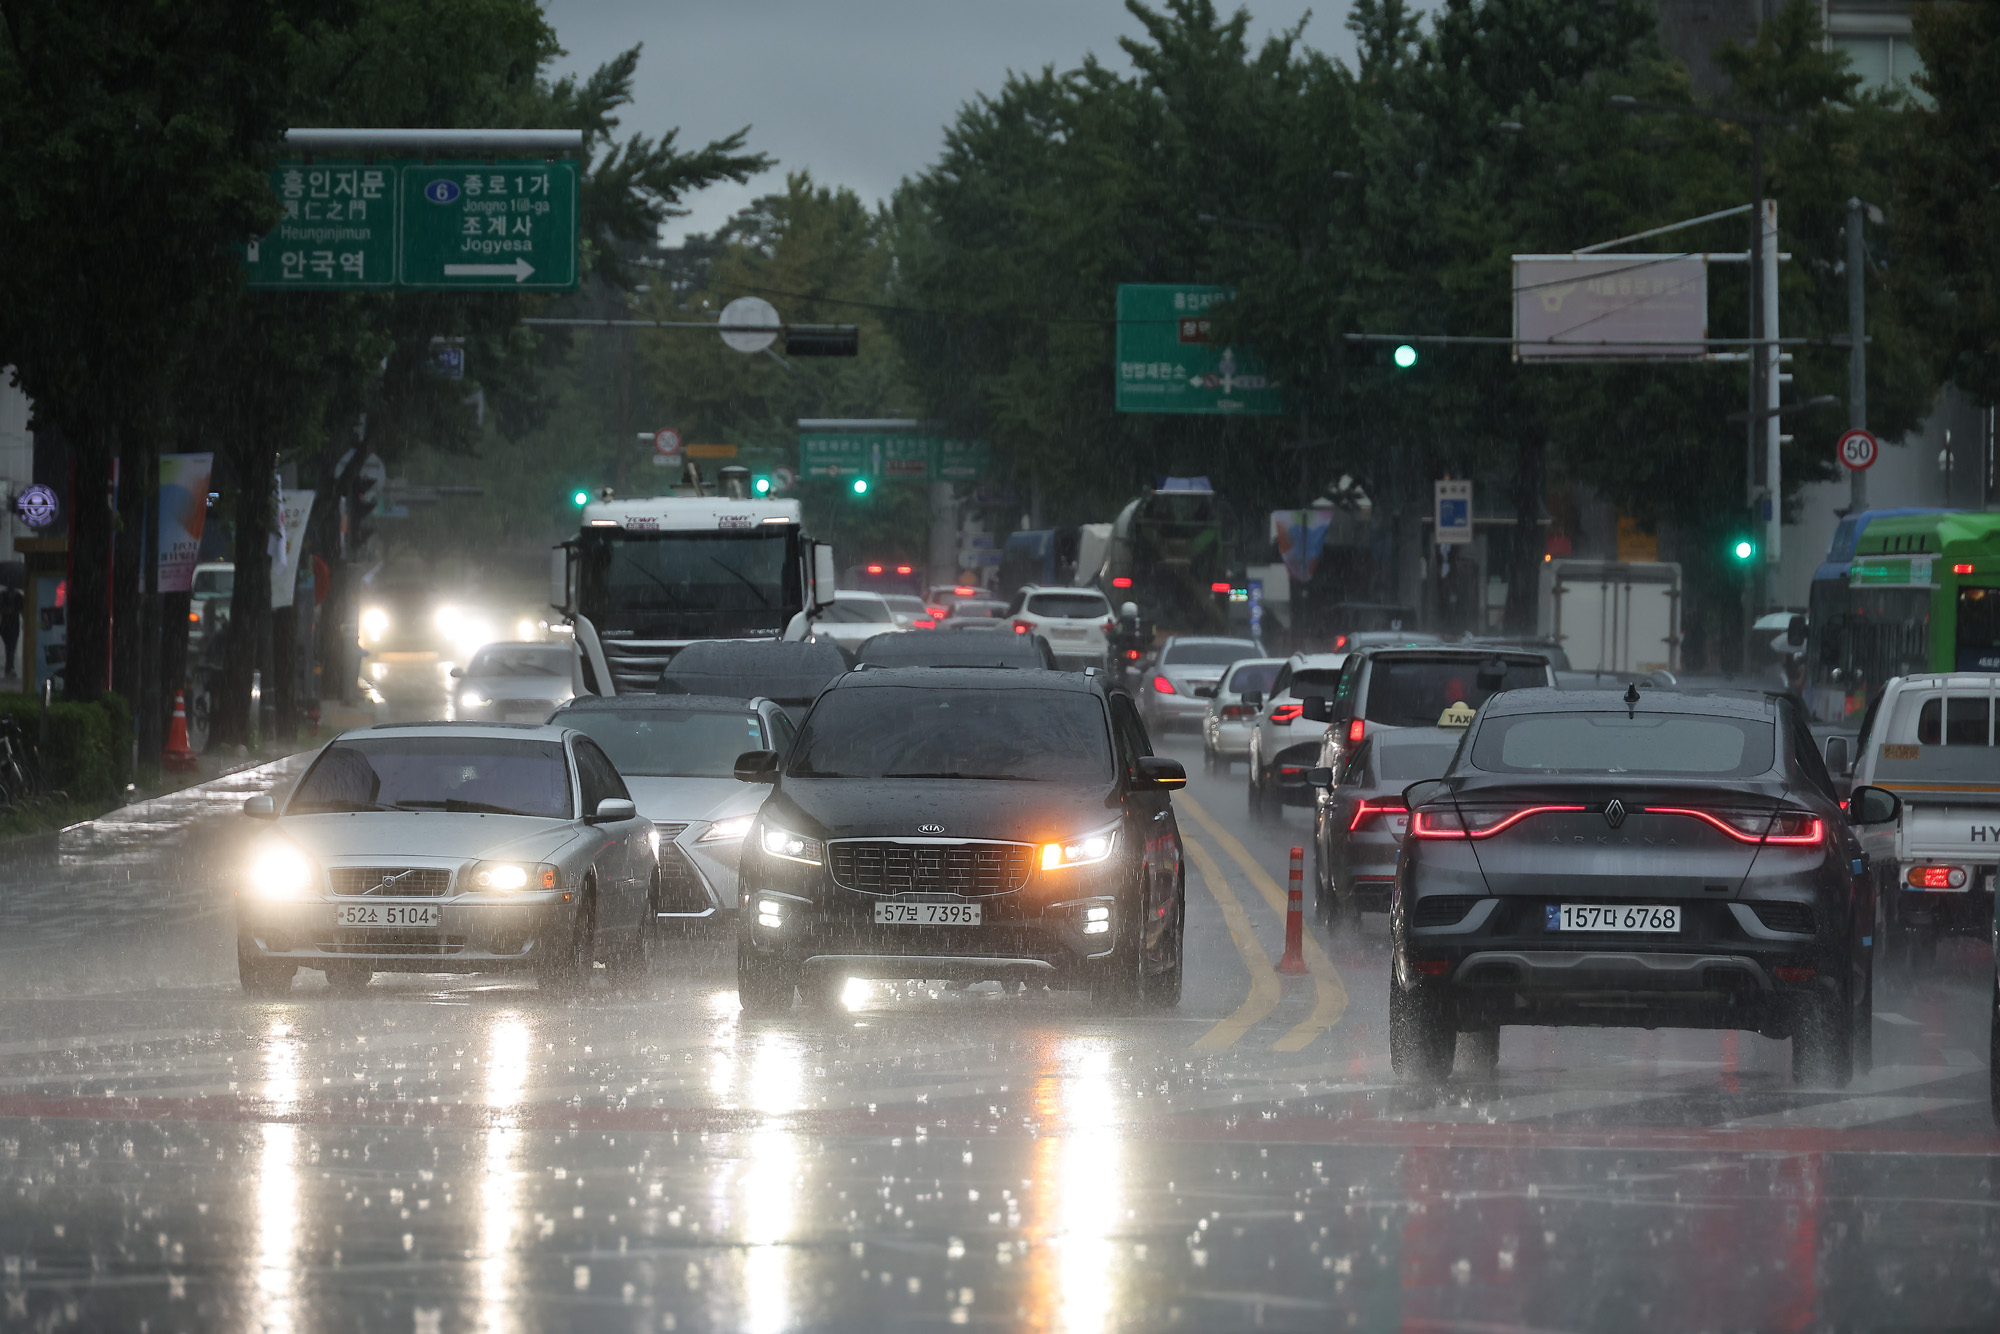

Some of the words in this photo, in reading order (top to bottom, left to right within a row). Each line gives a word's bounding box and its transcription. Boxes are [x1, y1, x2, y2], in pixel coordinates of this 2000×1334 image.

[280, 169, 386, 199] 흥인지문
[435, 183, 449, 201] 6
[462, 173, 550, 196] 종로1가
[462, 199, 507, 215] Jongno
[280, 225, 371, 244] Heunginjimun
[461, 215, 533, 237] 조계사
[461, 237, 533, 254] Jogyesa
[280, 250, 365, 280] 안국역
[1846, 439, 1870, 460] 50
[1448, 713, 1473, 724] TAXI
[922, 824, 941, 832] KIA
[1971, 825, 2000, 842] HY
[1551, 834, 1680, 846] ARKANA
[346, 907, 379, 924] 52소
[386, 906, 430, 924] 5104
[884, 905, 918, 922] 57보
[926, 905, 973, 922] 7395
[1563, 907, 1618, 928] 157다
[1623, 908, 1676, 929] 6768
